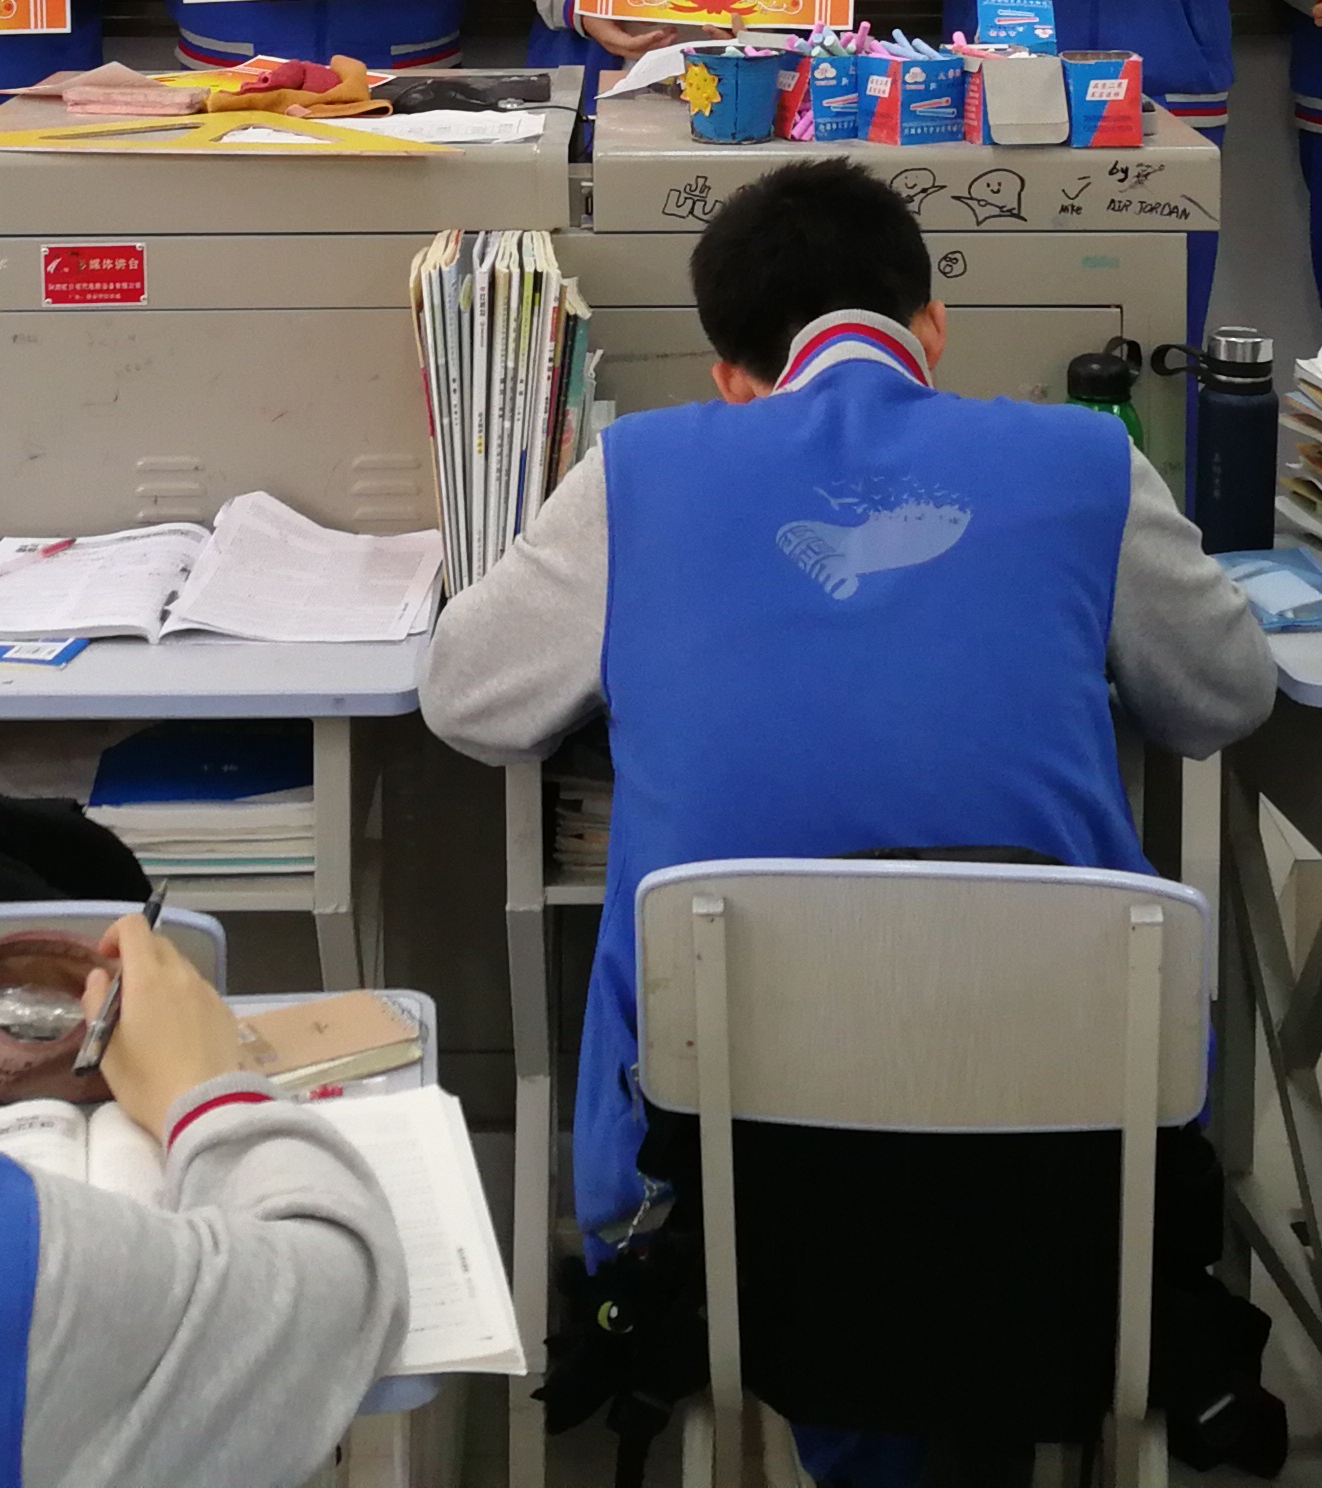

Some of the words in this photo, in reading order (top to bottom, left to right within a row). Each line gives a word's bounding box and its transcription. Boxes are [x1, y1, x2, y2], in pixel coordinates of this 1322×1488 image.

[1108, 160, 1129, 183] by
[1106, 198, 1133, 214] AIR
[1135, 199, 1191, 221] JORDAN
